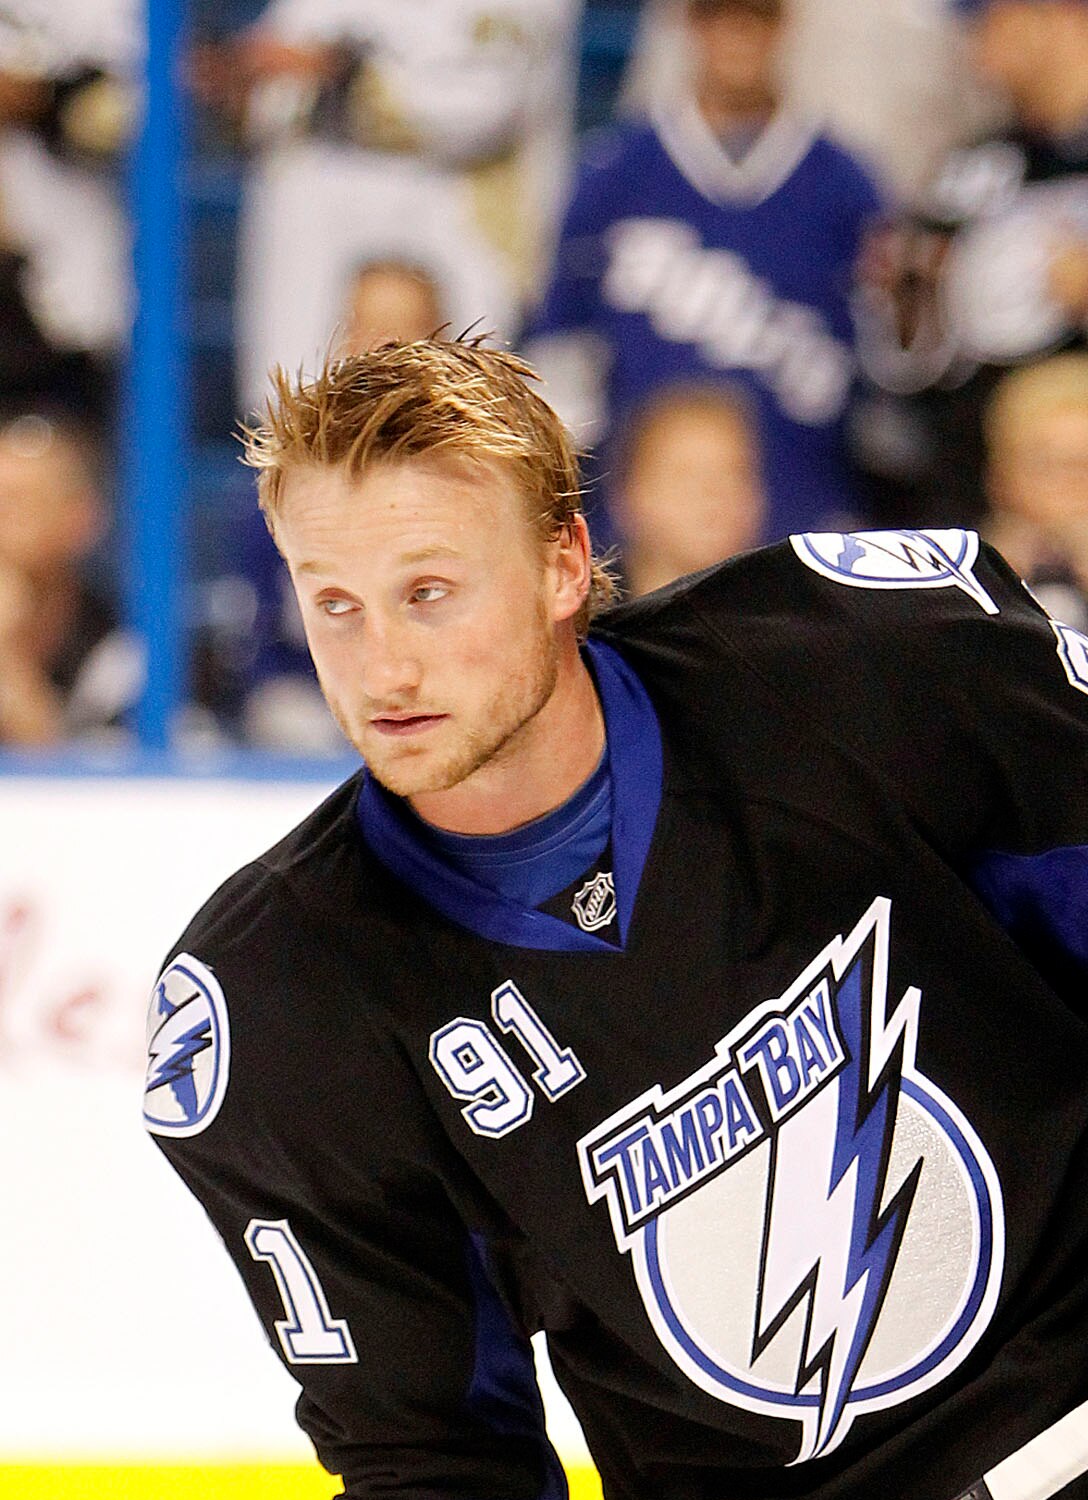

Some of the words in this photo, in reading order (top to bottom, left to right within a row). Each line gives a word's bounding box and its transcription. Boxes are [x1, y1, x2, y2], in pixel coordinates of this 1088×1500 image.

[429, 979, 588, 1139] 91
[594, 1070, 763, 1224] TAMPA
[738, 982, 842, 1120] BAY
